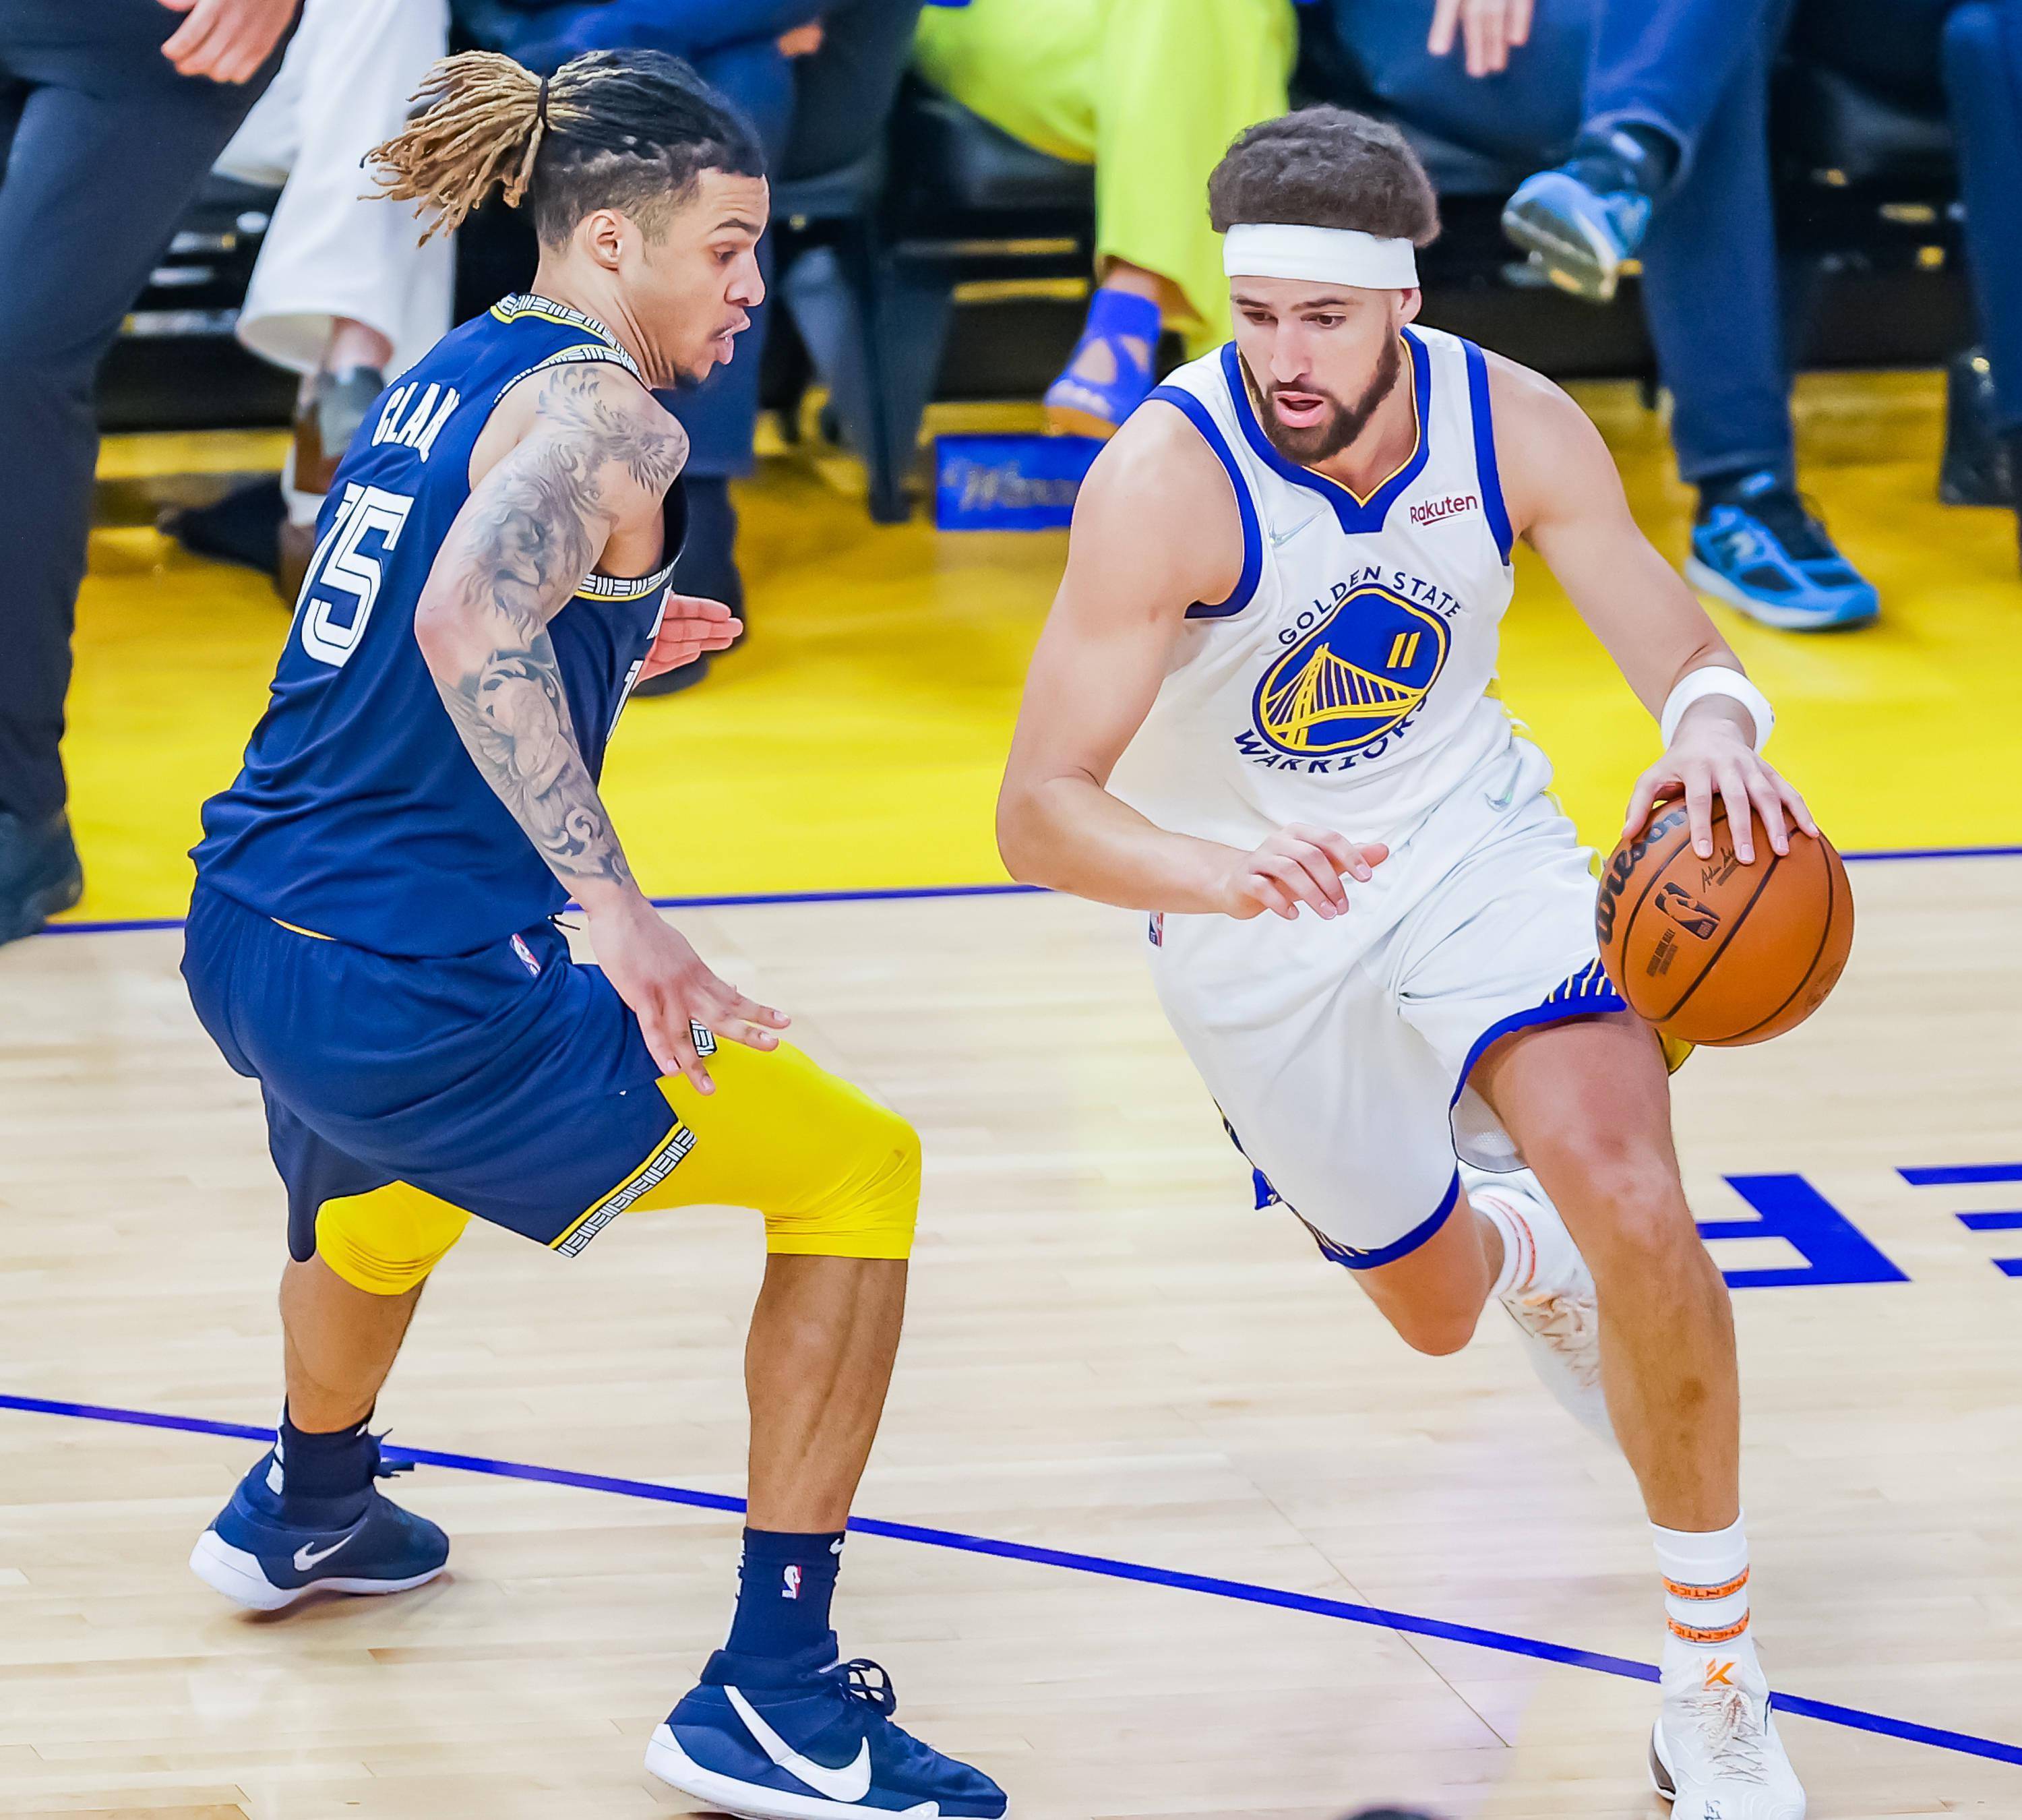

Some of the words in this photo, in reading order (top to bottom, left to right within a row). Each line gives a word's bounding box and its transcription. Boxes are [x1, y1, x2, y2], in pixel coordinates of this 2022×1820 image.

[1409, 494, 1478, 525] Rakuten
[282, 481, 415, 669] 15
[1278, 566, 1382, 645] GOLDEN
[1394, 572, 1461, 619] STATE
[1386, 632, 1421, 669] 11
